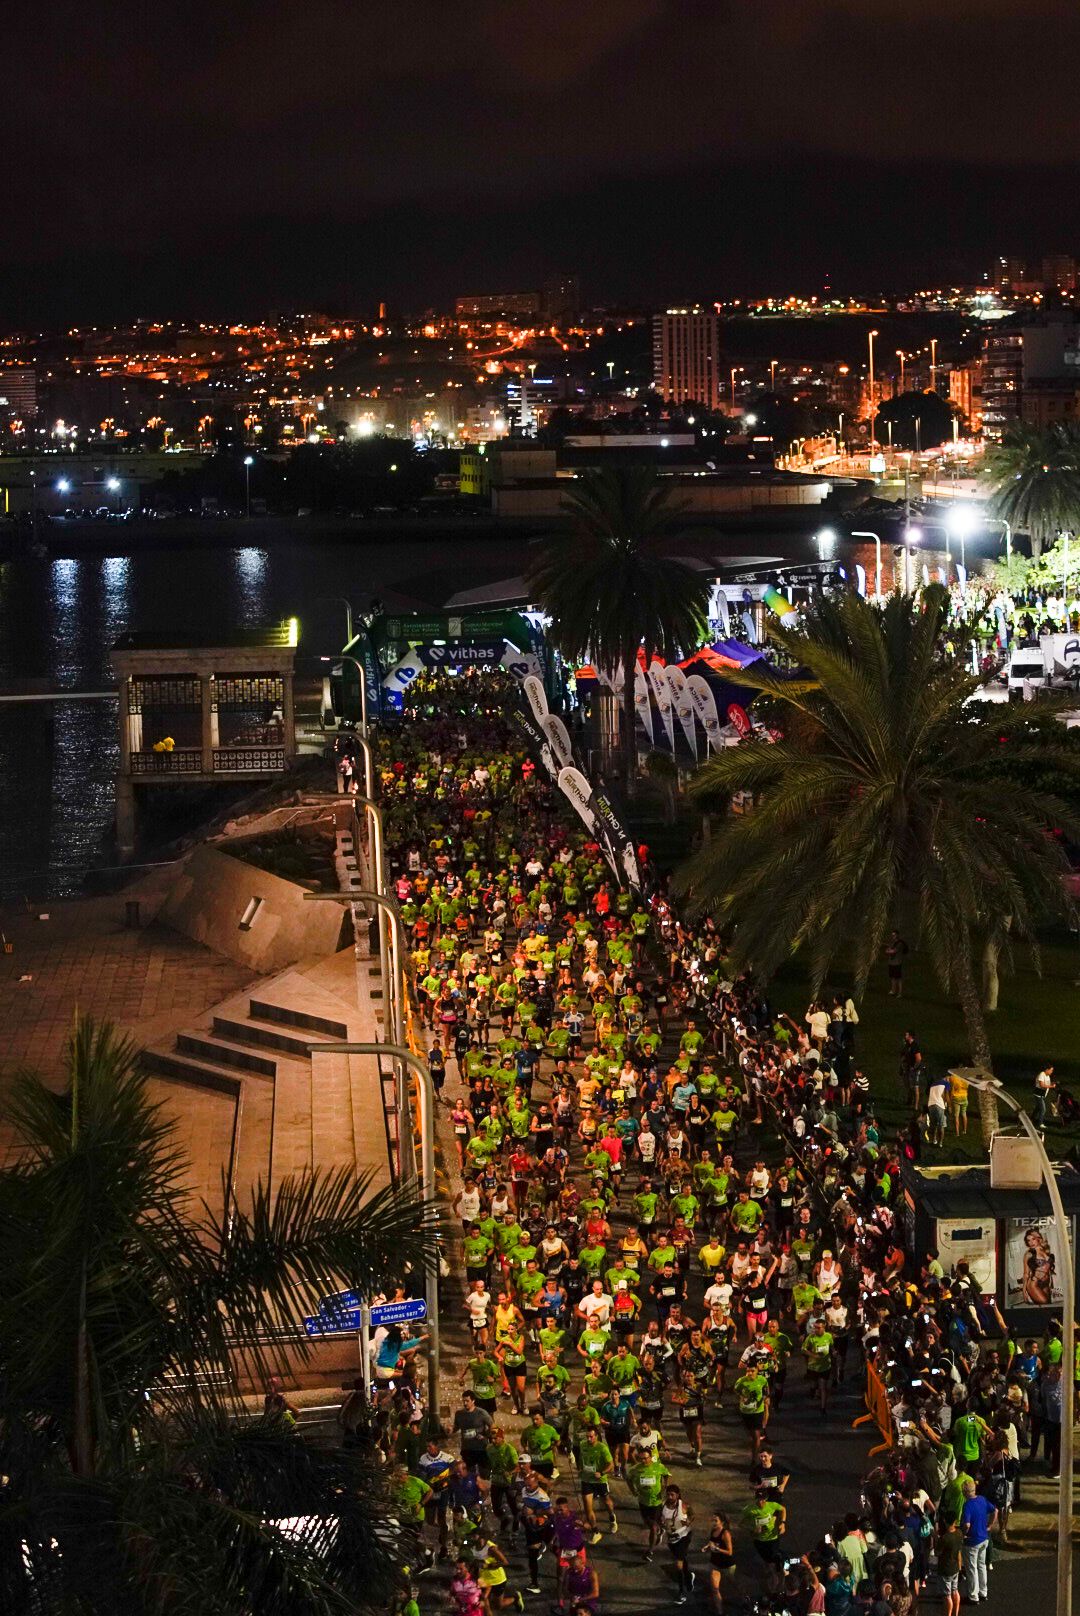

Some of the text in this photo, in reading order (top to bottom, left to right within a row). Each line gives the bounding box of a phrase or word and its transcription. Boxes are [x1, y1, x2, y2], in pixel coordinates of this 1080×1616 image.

[448, 647, 495, 660] vithas
[365, 652, 376, 687] vithas
[1012, 1215, 1069, 1228] TEZENS
[383, 1304, 407, 1313] Salvador
